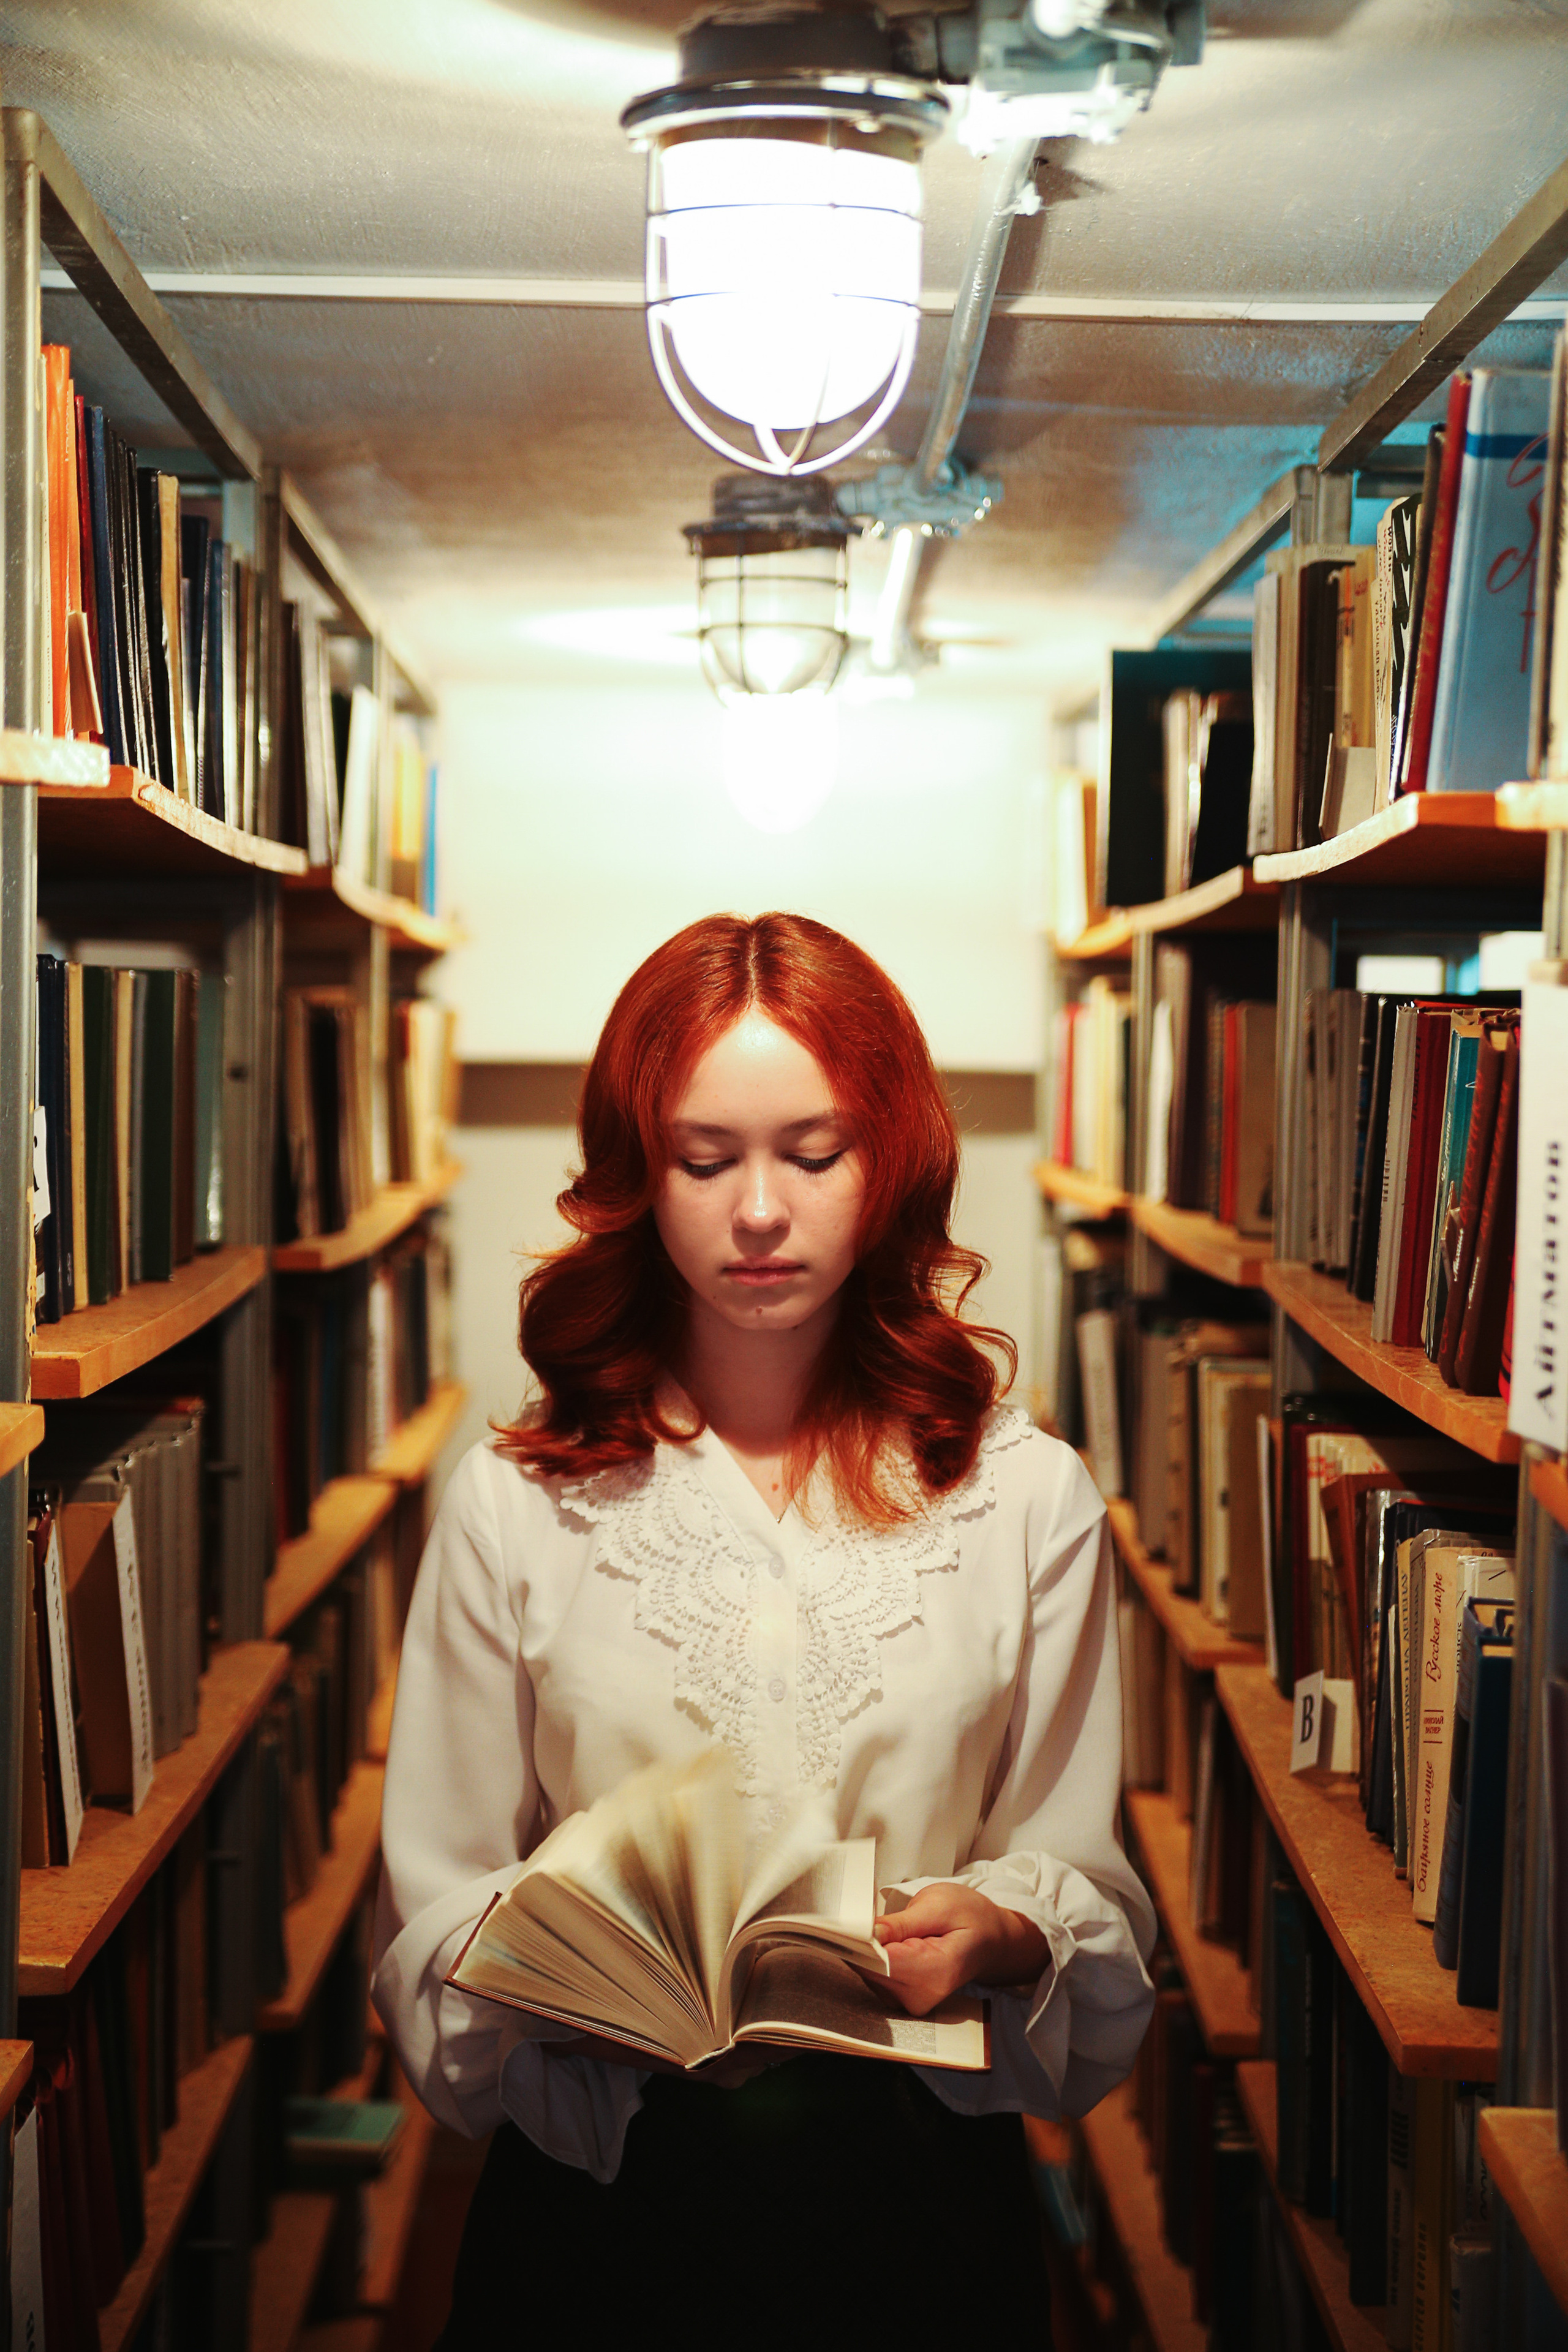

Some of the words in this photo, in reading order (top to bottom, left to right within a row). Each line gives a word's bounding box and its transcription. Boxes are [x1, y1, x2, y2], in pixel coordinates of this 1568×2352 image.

[1425, 1618, 1442, 1683] Русское
[1434, 1572, 1445, 1613] море
[1417, 1819, 1430, 1893] Багряное
[1424, 1761, 1434, 1814] солнце
